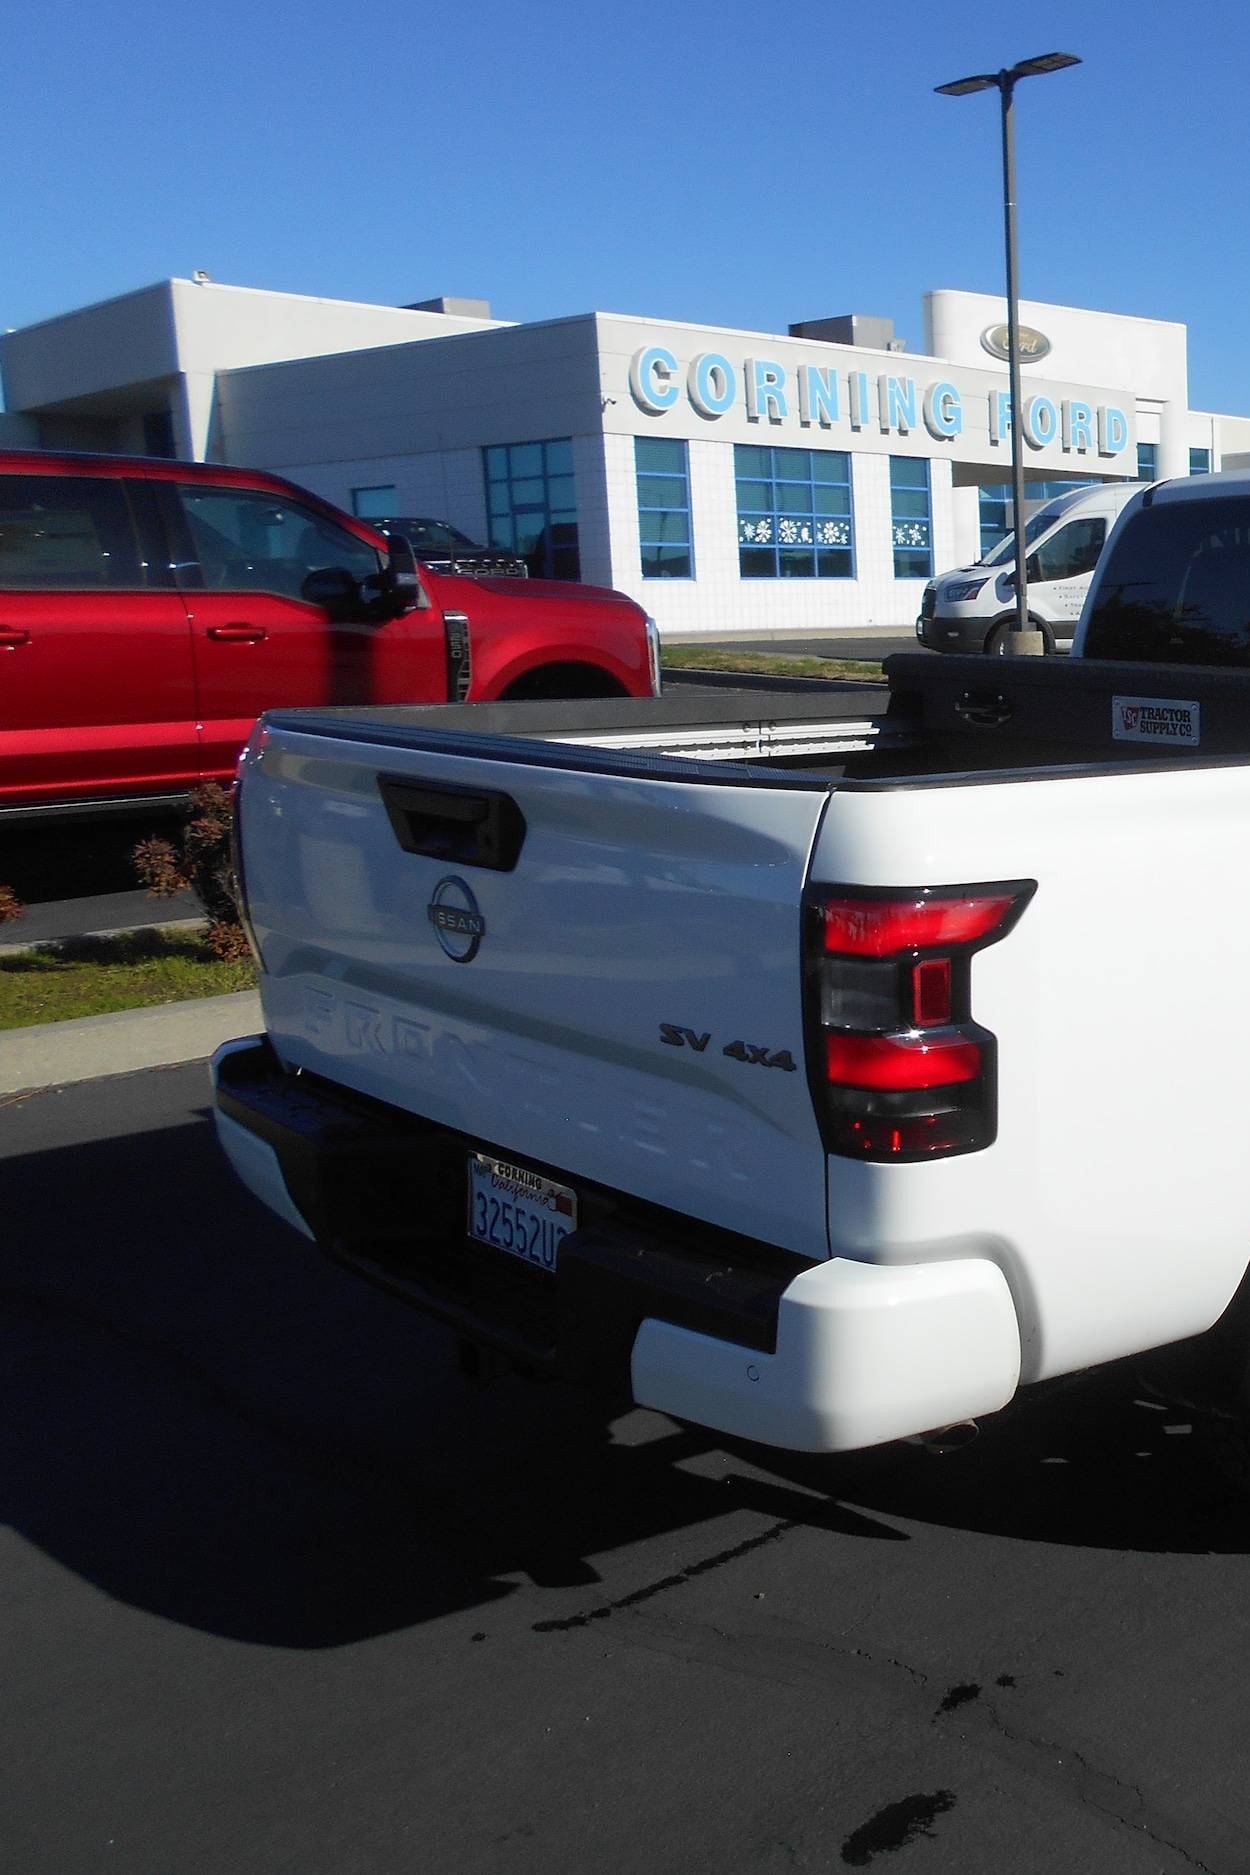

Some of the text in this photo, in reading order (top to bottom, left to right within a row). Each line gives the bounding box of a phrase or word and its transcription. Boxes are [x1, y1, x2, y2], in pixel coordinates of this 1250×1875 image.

[630, 346, 1128, 454] CORNING FORD
[1122, 707, 1137, 727] TSC
[1140, 706, 1191, 723] TRACTOR
[1140, 720, 1179, 736] SUPPLY
[433, 909, 481, 932] SSAN
[659, 1023, 711, 1052] SV
[302, 984, 750, 1182] FRONER
[498, 1163, 542, 1190] CORNING
[476, 1191, 568, 1266] 32552U
